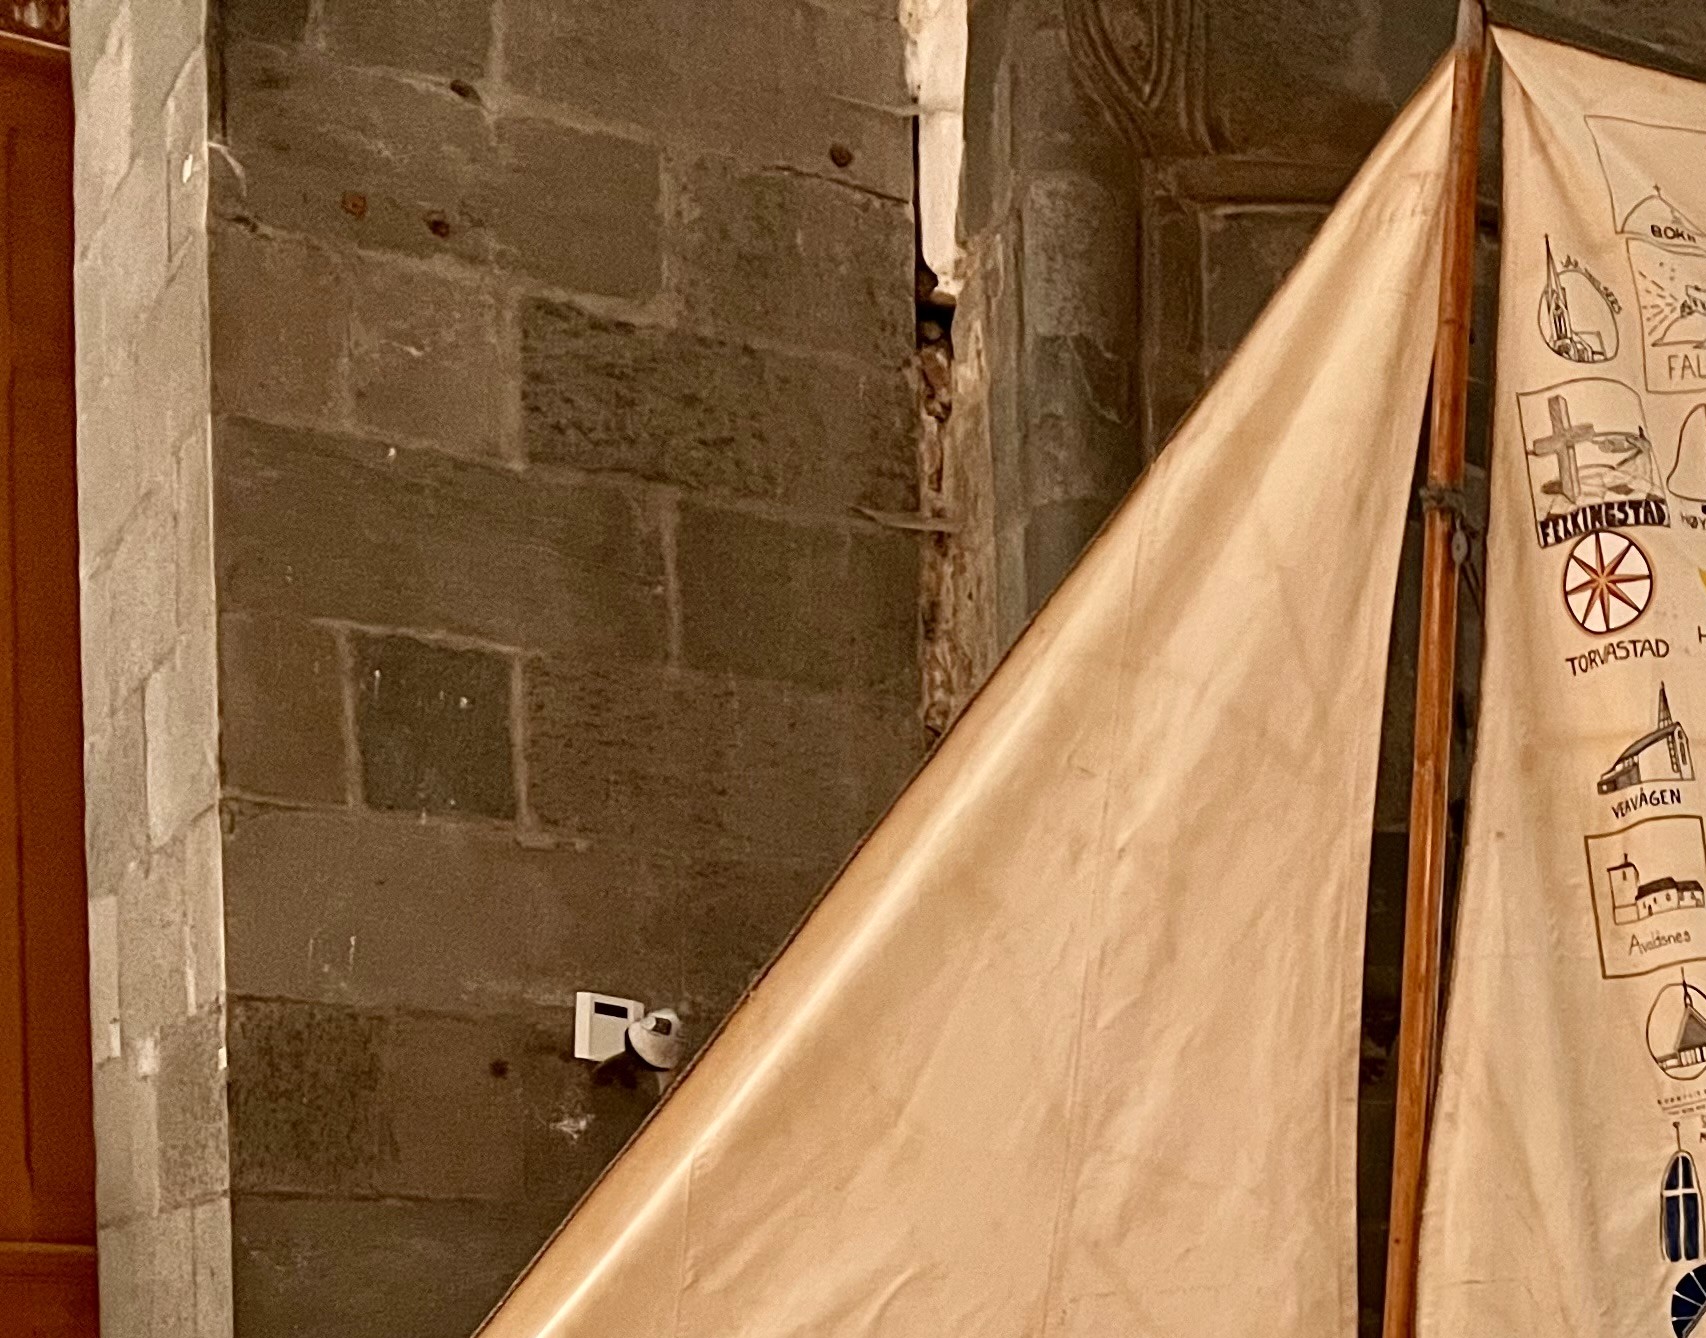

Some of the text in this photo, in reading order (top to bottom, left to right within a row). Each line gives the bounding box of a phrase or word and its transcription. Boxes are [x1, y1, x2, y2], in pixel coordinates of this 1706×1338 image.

[1540, 500, 1667, 546] FERKINGSTAD
[1565, 638, 1670, 676] TORVASTAD
[1612, 787, 1682, 819] VEAVÅGEN
